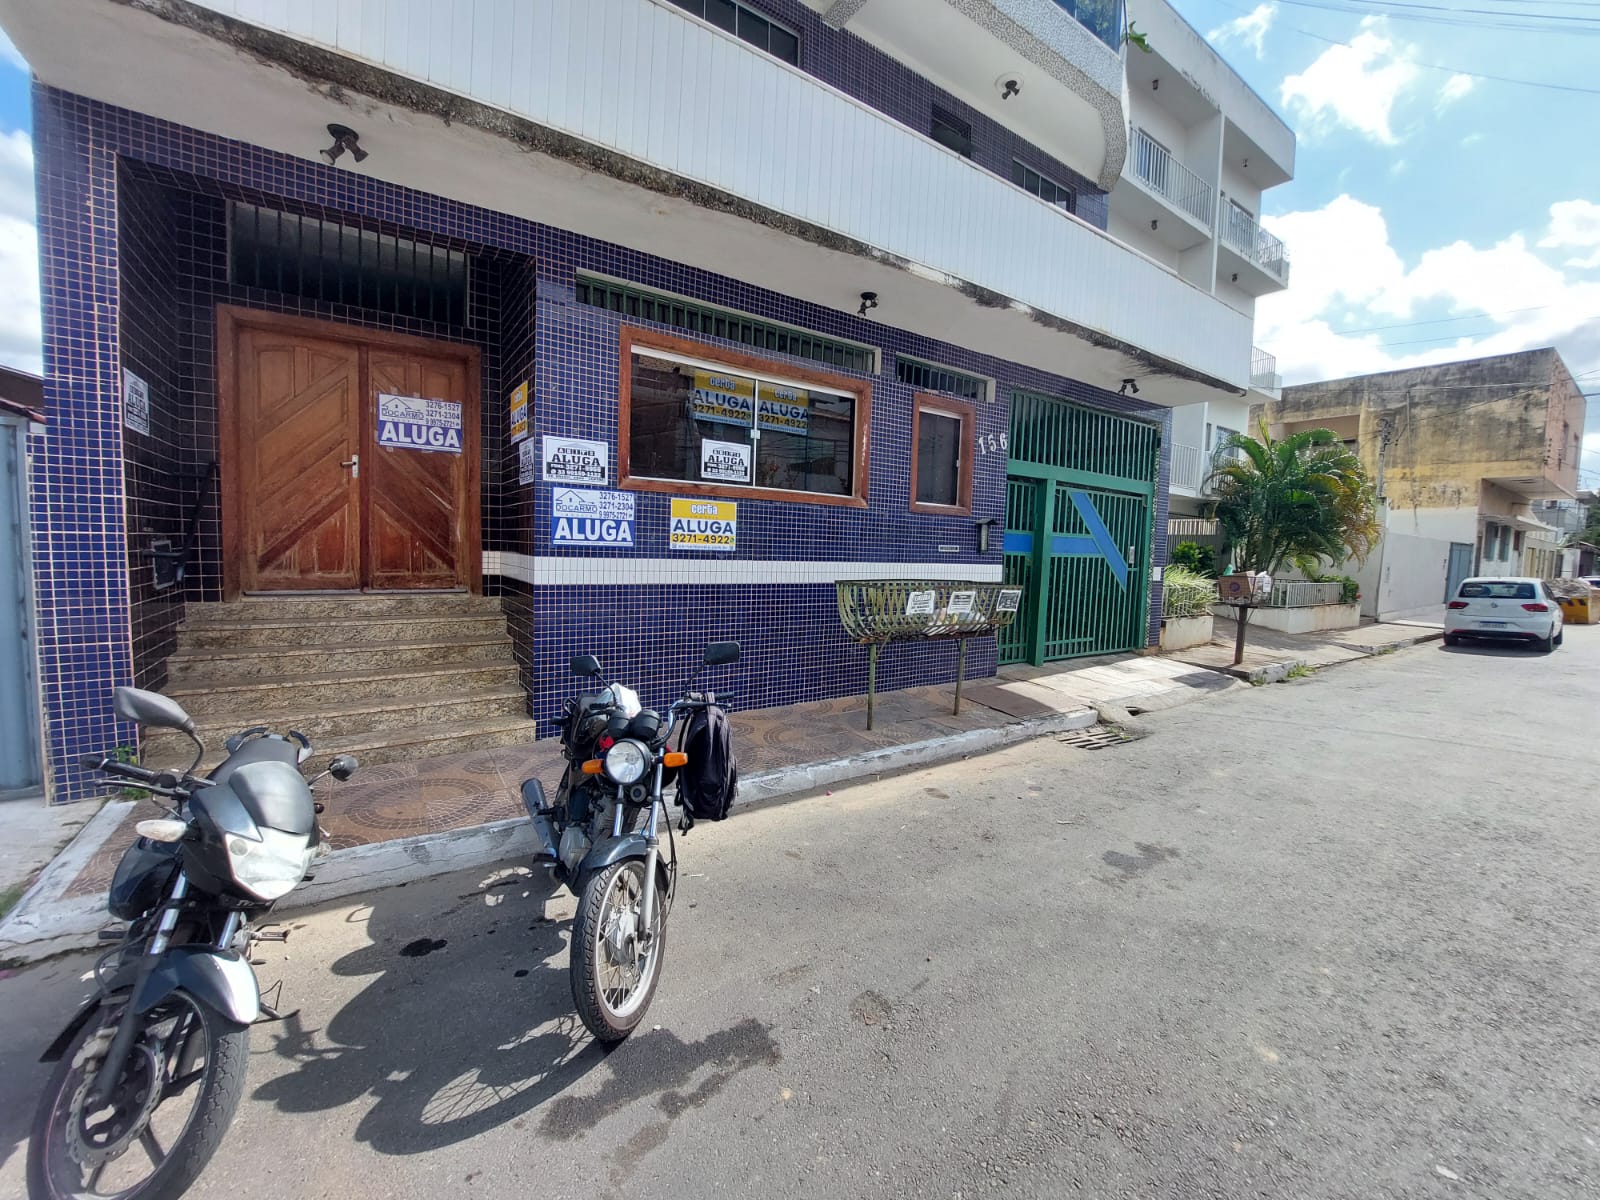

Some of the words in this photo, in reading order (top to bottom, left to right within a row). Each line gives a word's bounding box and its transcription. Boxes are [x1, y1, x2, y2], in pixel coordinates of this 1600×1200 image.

[426, 401, 460, 411] 3276-1527
[694, 390, 750, 411] ALUGA
[426, 409, 460, 420] 3271-2304
[693, 404, 746, 420] 3271-4922
[760, 401, 808, 420] ALUGA
[759, 413, 807, 428] 3271-4922
[381, 421, 460, 447] ALUGA
[979, 433, 1007, 454] 156
[551, 454, 600, 466] ALUGA
[708, 454, 744, 466] ALUGA
[599, 492, 633, 501] 3276-1527
[555, 503, 598, 513] DOCARMO
[599, 501, 633, 511] 3271-2304
[691, 504, 718, 515] certa
[603, 512, 628, 520] 9975-2721
[554, 518, 632, 542] ALUGA
[673, 519, 733, 535] ALUGA
[672, 533, 730, 545] 3271-4922
